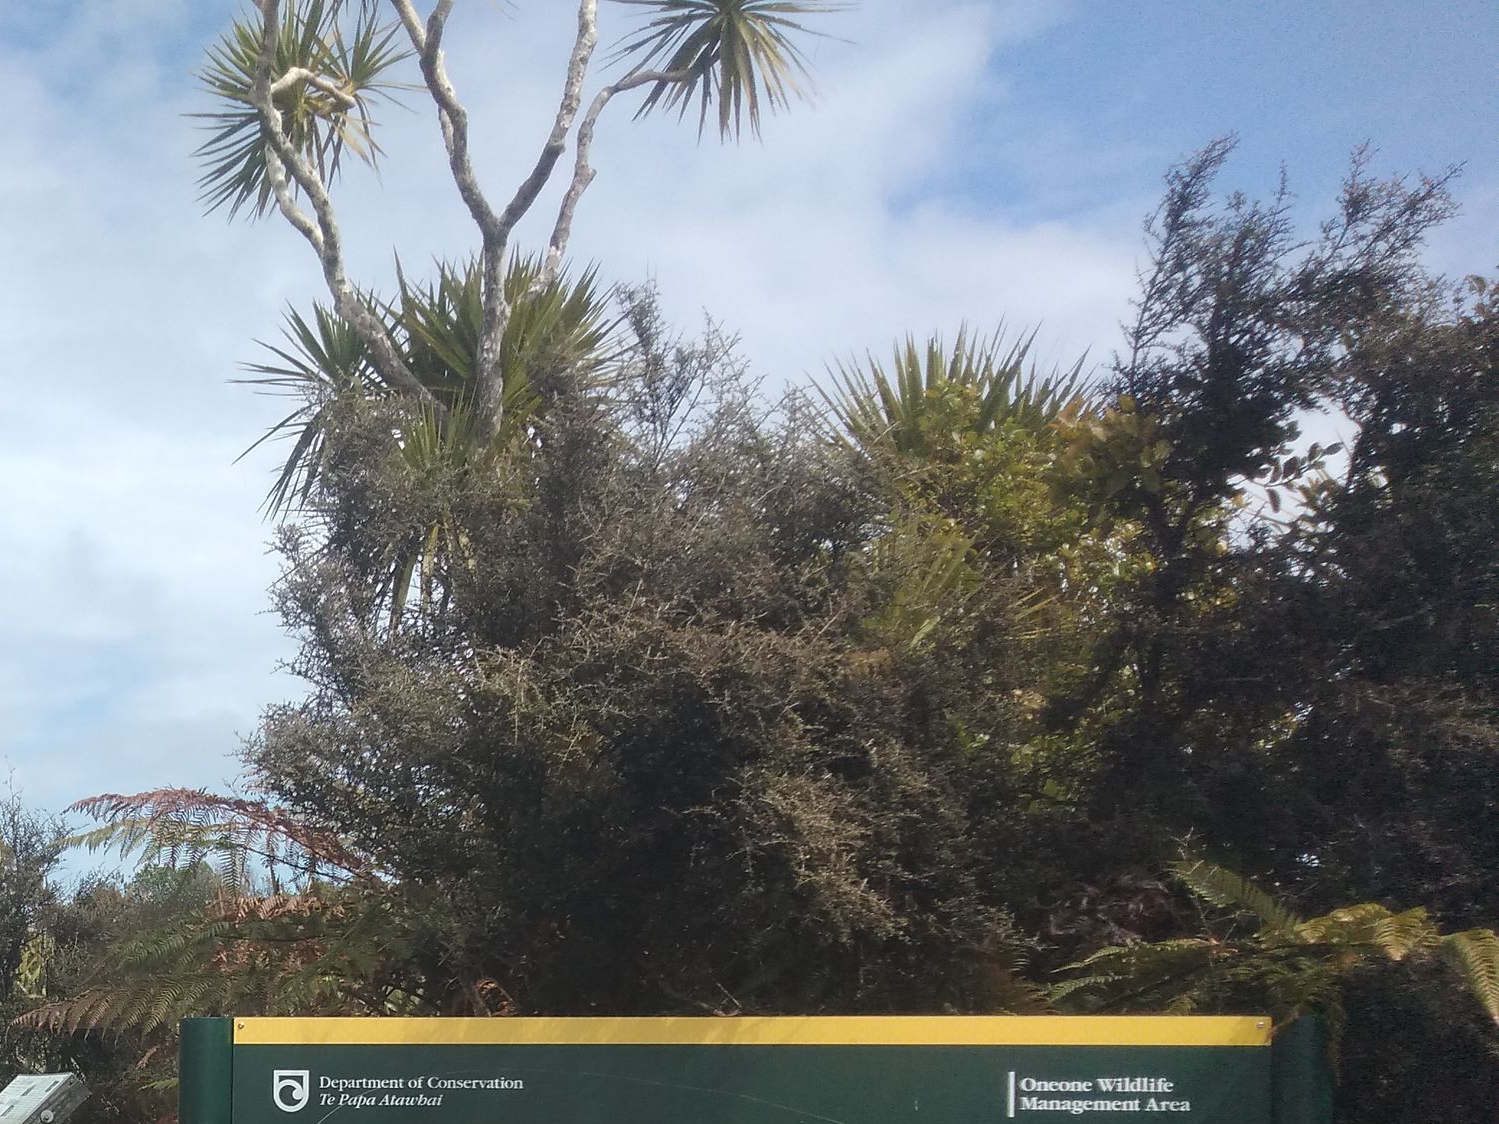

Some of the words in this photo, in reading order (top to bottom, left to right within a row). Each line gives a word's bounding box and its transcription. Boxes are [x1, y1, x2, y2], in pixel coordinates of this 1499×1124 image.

[319, 1076, 404, 1091] Department
[408, 1076, 423, 1089] of
[427, 1077, 524, 1090] Conservation
[1020, 1077, 1093, 1092] Oneone
[1097, 1077, 1174, 1093] Wildlife
[319, 1093, 335, 1106] Te
[338, 1094, 376, 1109] Papa
[378, 1094, 443, 1106] Atawhai
[1020, 1097, 1141, 1115] Management
[1145, 1098, 1191, 1112] Area
